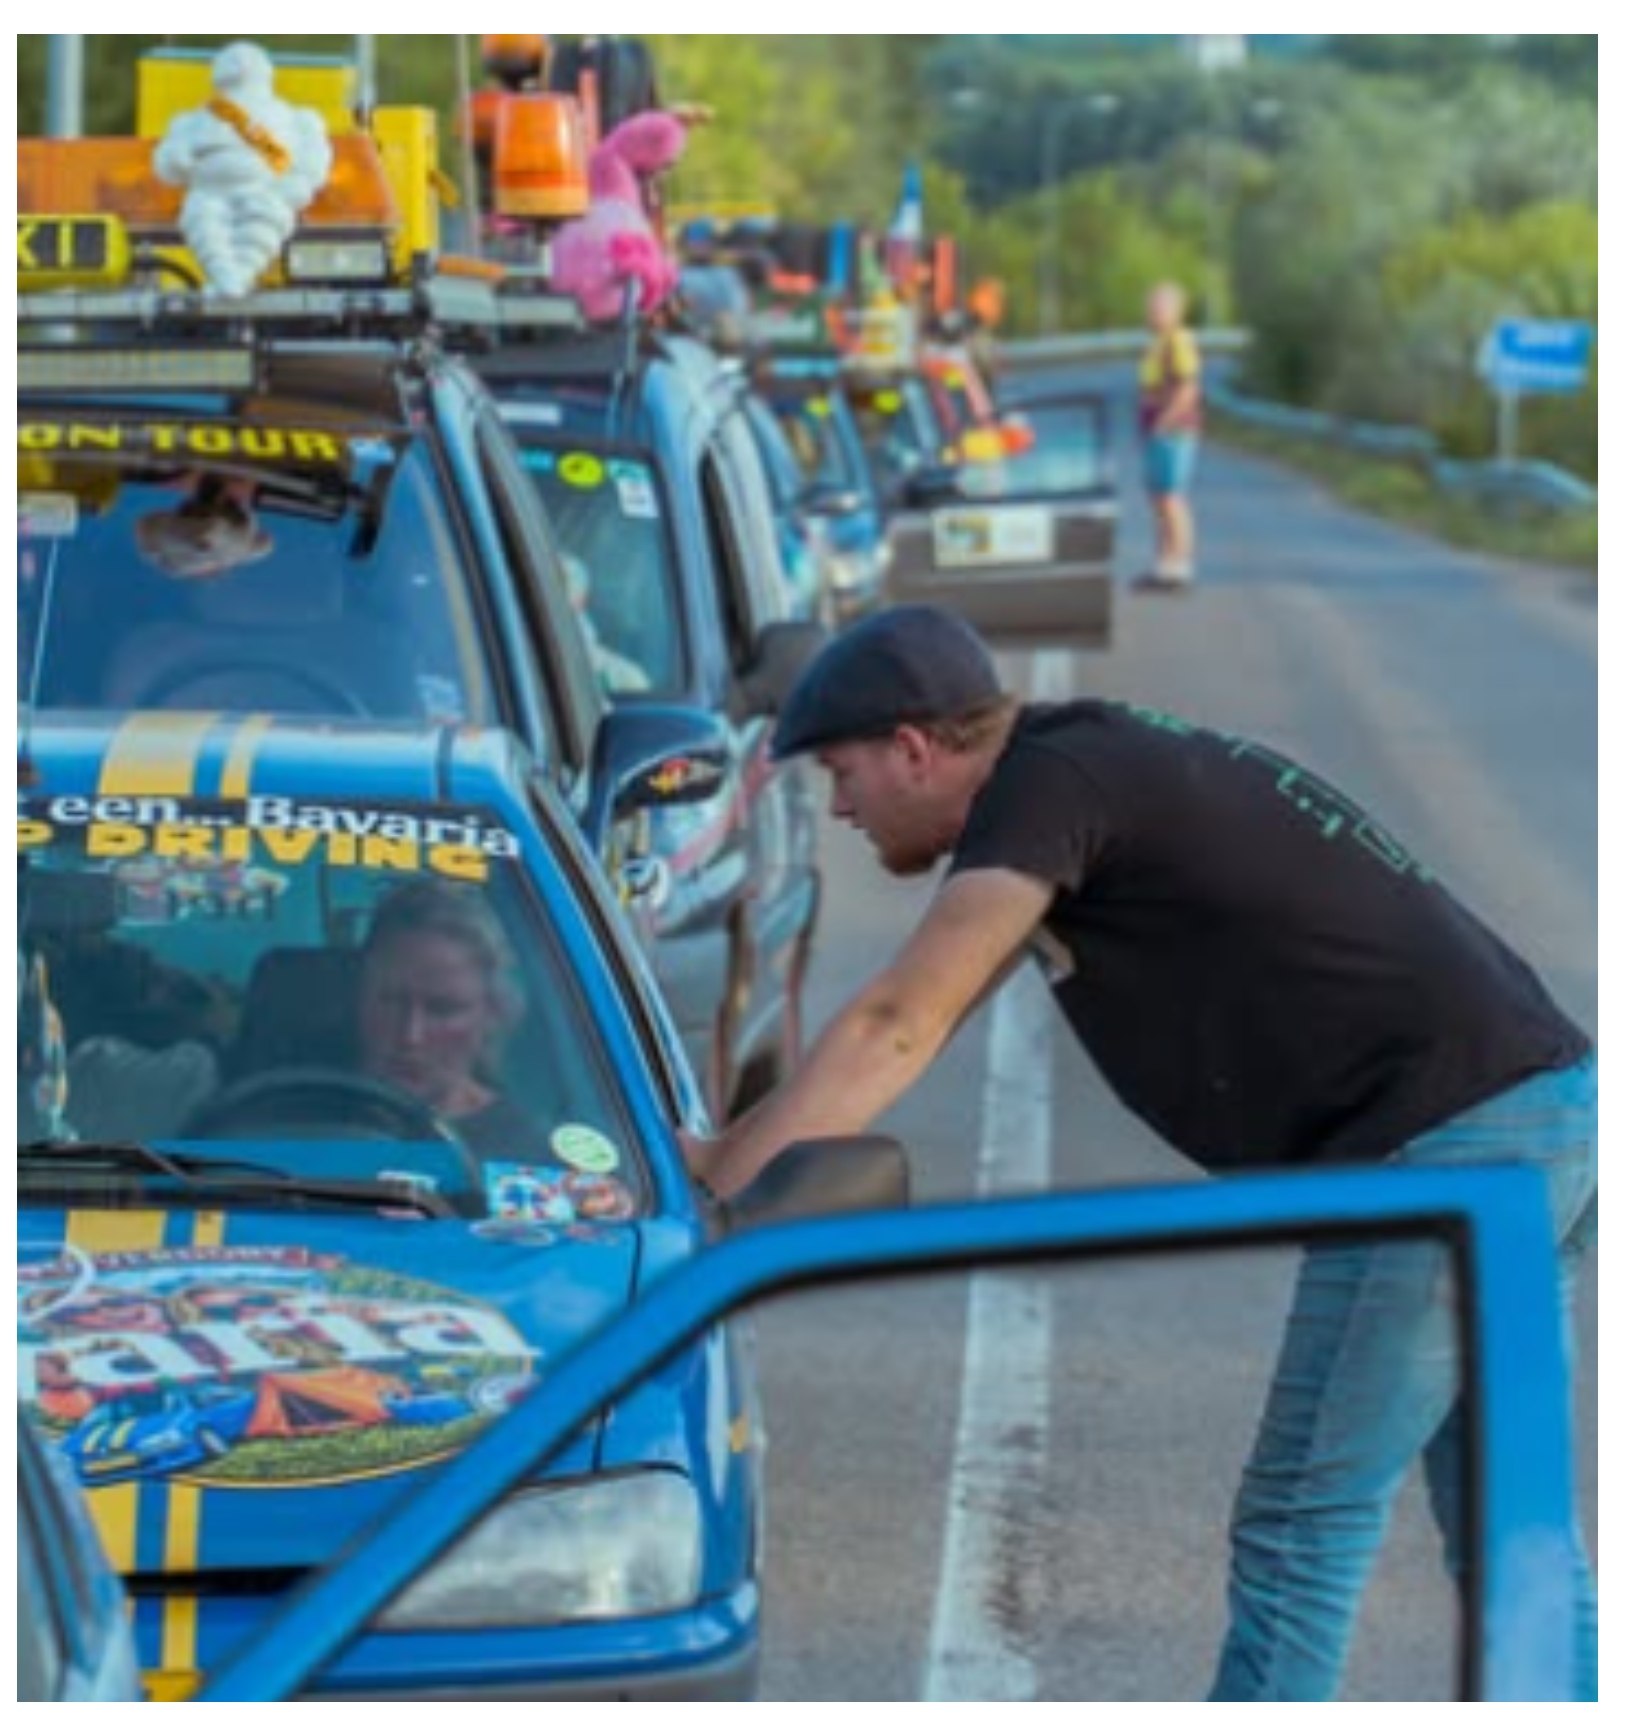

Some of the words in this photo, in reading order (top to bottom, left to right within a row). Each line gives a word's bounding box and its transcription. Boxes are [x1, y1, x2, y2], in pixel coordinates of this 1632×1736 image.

[18, 423, 120, 449] ON
[144, 424, 340, 461] TOUR
[86, 820, 489, 882] DRIVING
[246, 796, 520, 858] Bavaria
